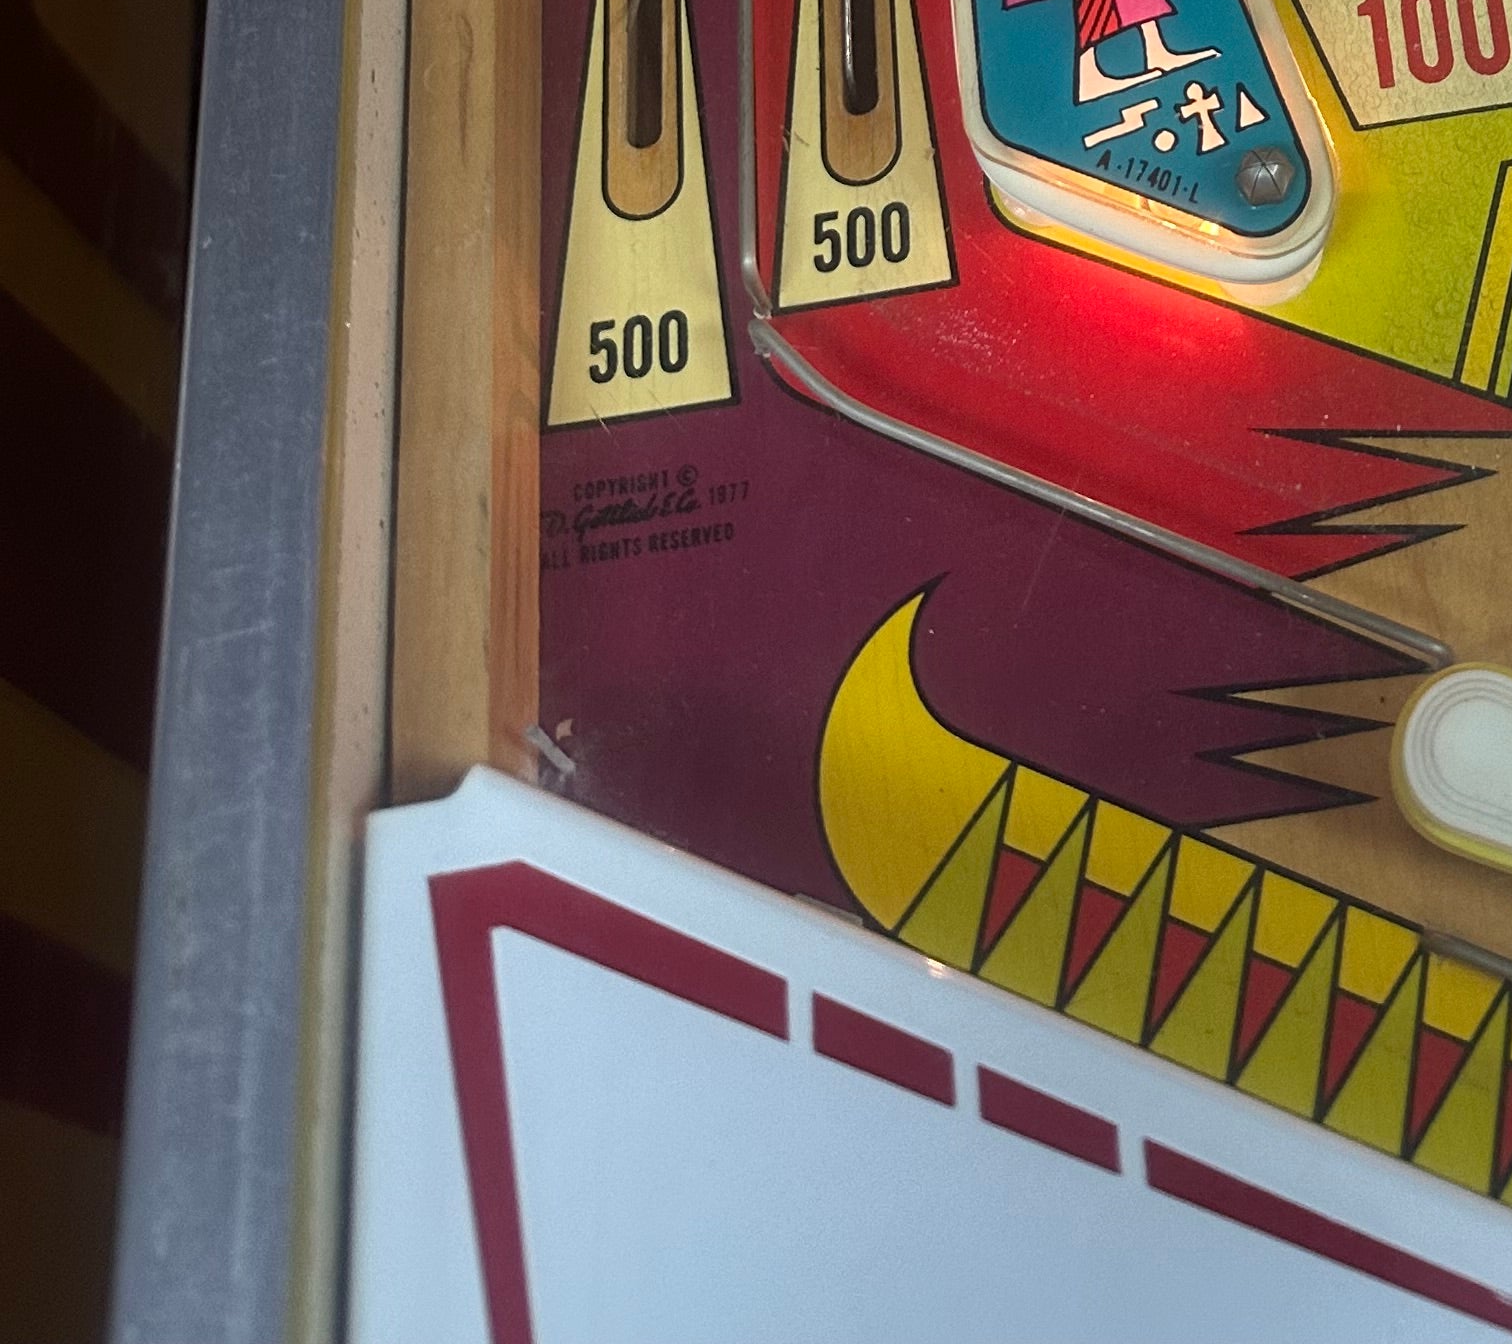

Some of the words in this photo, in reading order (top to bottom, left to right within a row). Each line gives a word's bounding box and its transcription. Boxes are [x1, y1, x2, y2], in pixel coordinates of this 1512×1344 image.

[813, 201, 911, 273] 500
[588, 308, 689, 384] 500
[573, 469, 669, 502] COPYRIGHT
[708, 481, 750, 505] 1977
[579, 538, 642, 564] RIGHTS
[648, 522, 736, 553] RESERVED
